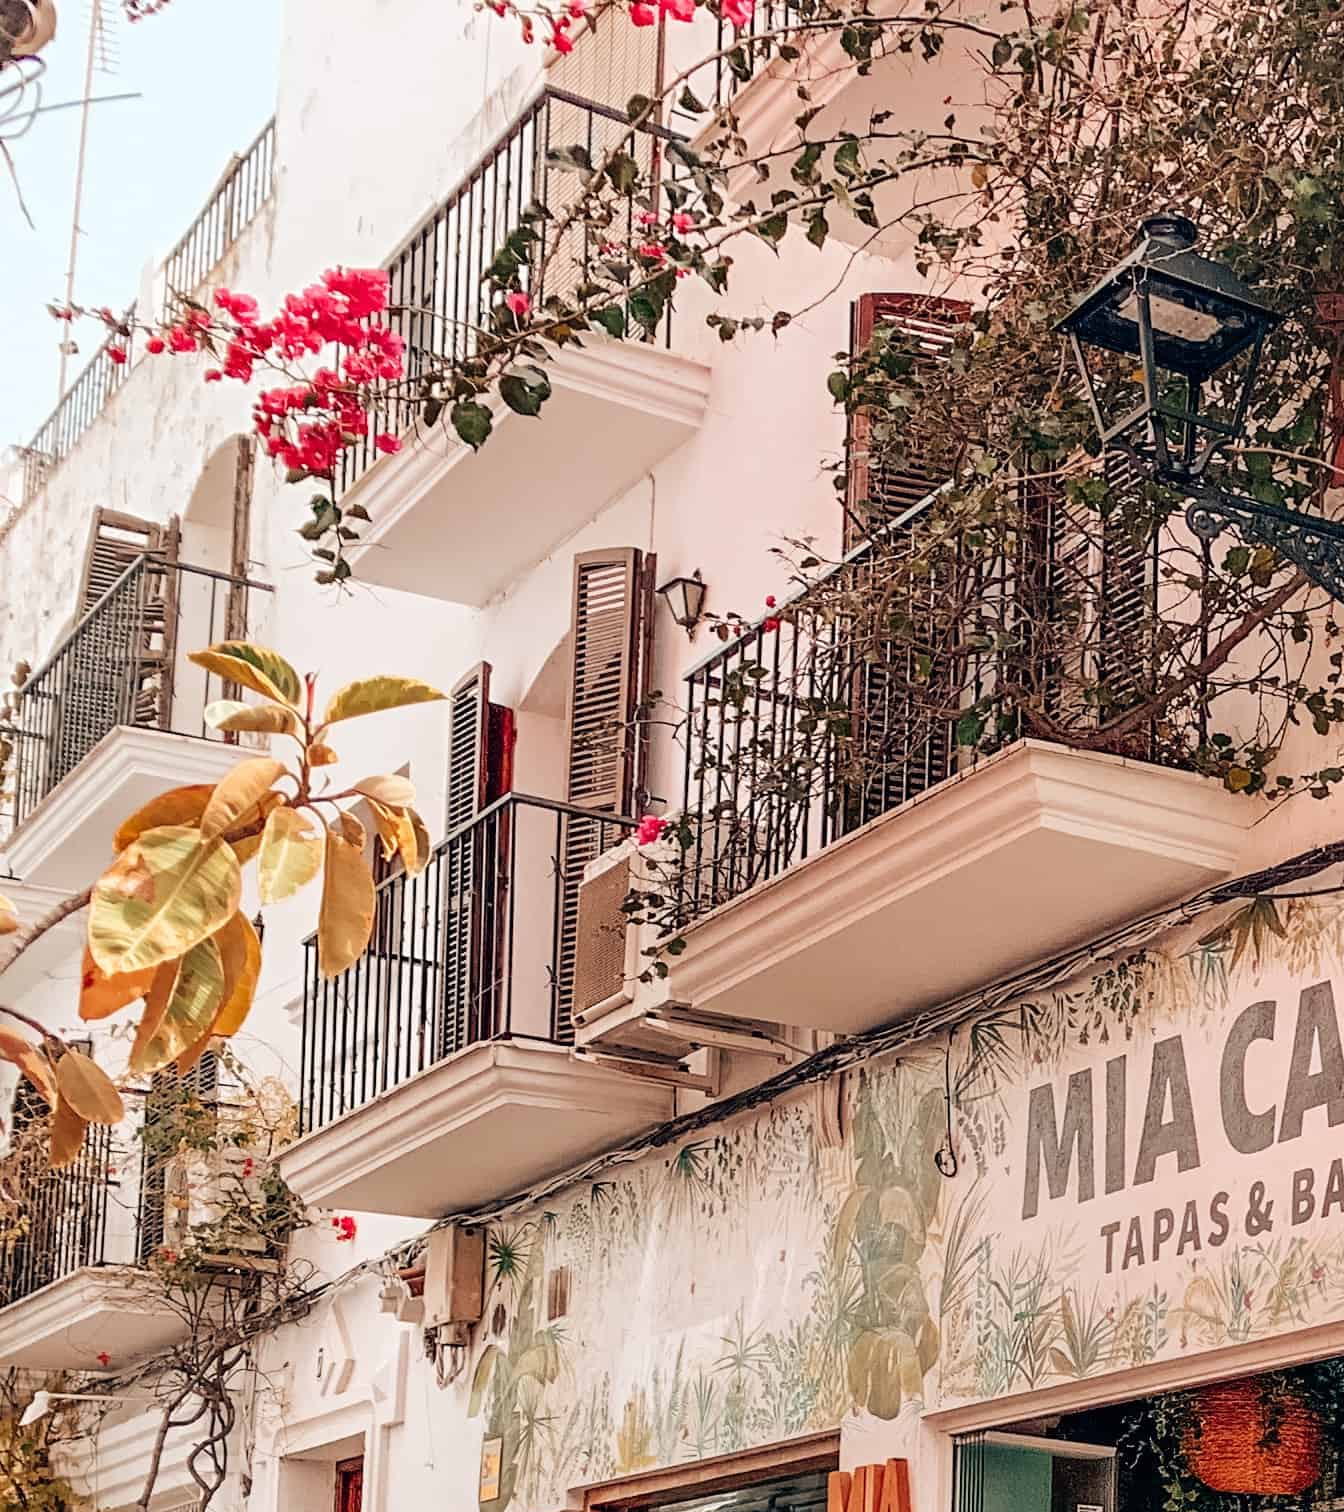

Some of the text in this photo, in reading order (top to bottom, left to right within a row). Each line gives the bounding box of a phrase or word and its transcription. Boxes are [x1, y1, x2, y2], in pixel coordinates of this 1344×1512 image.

[1022, 1033, 1200, 1220] MIA
[1100, 1190, 1231, 1275] TAPAS
[1244, 1180, 1273, 1238] &
